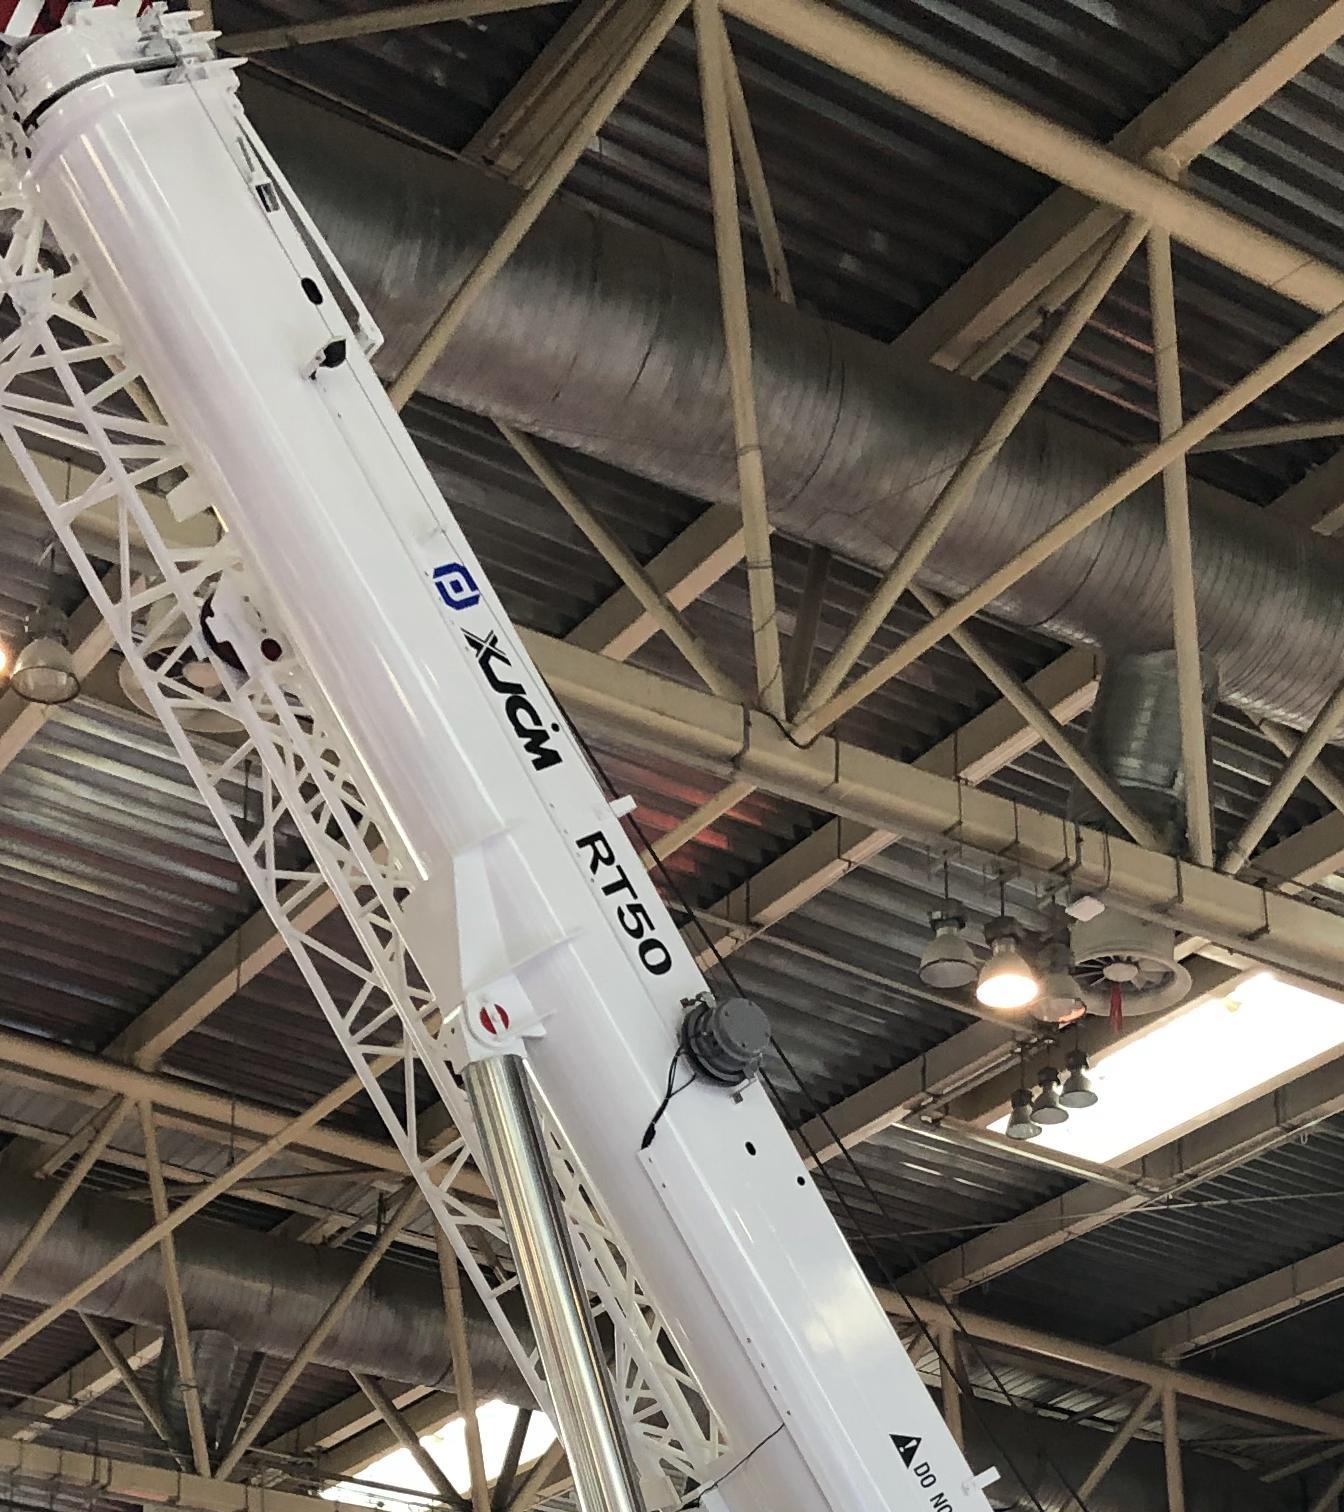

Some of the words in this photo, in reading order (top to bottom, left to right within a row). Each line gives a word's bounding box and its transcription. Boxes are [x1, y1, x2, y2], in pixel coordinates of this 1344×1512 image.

[460, 627, 563, 771] XJCM
[575, 830, 673, 976] RT50
[913, 1461, 937, 1489] DO
